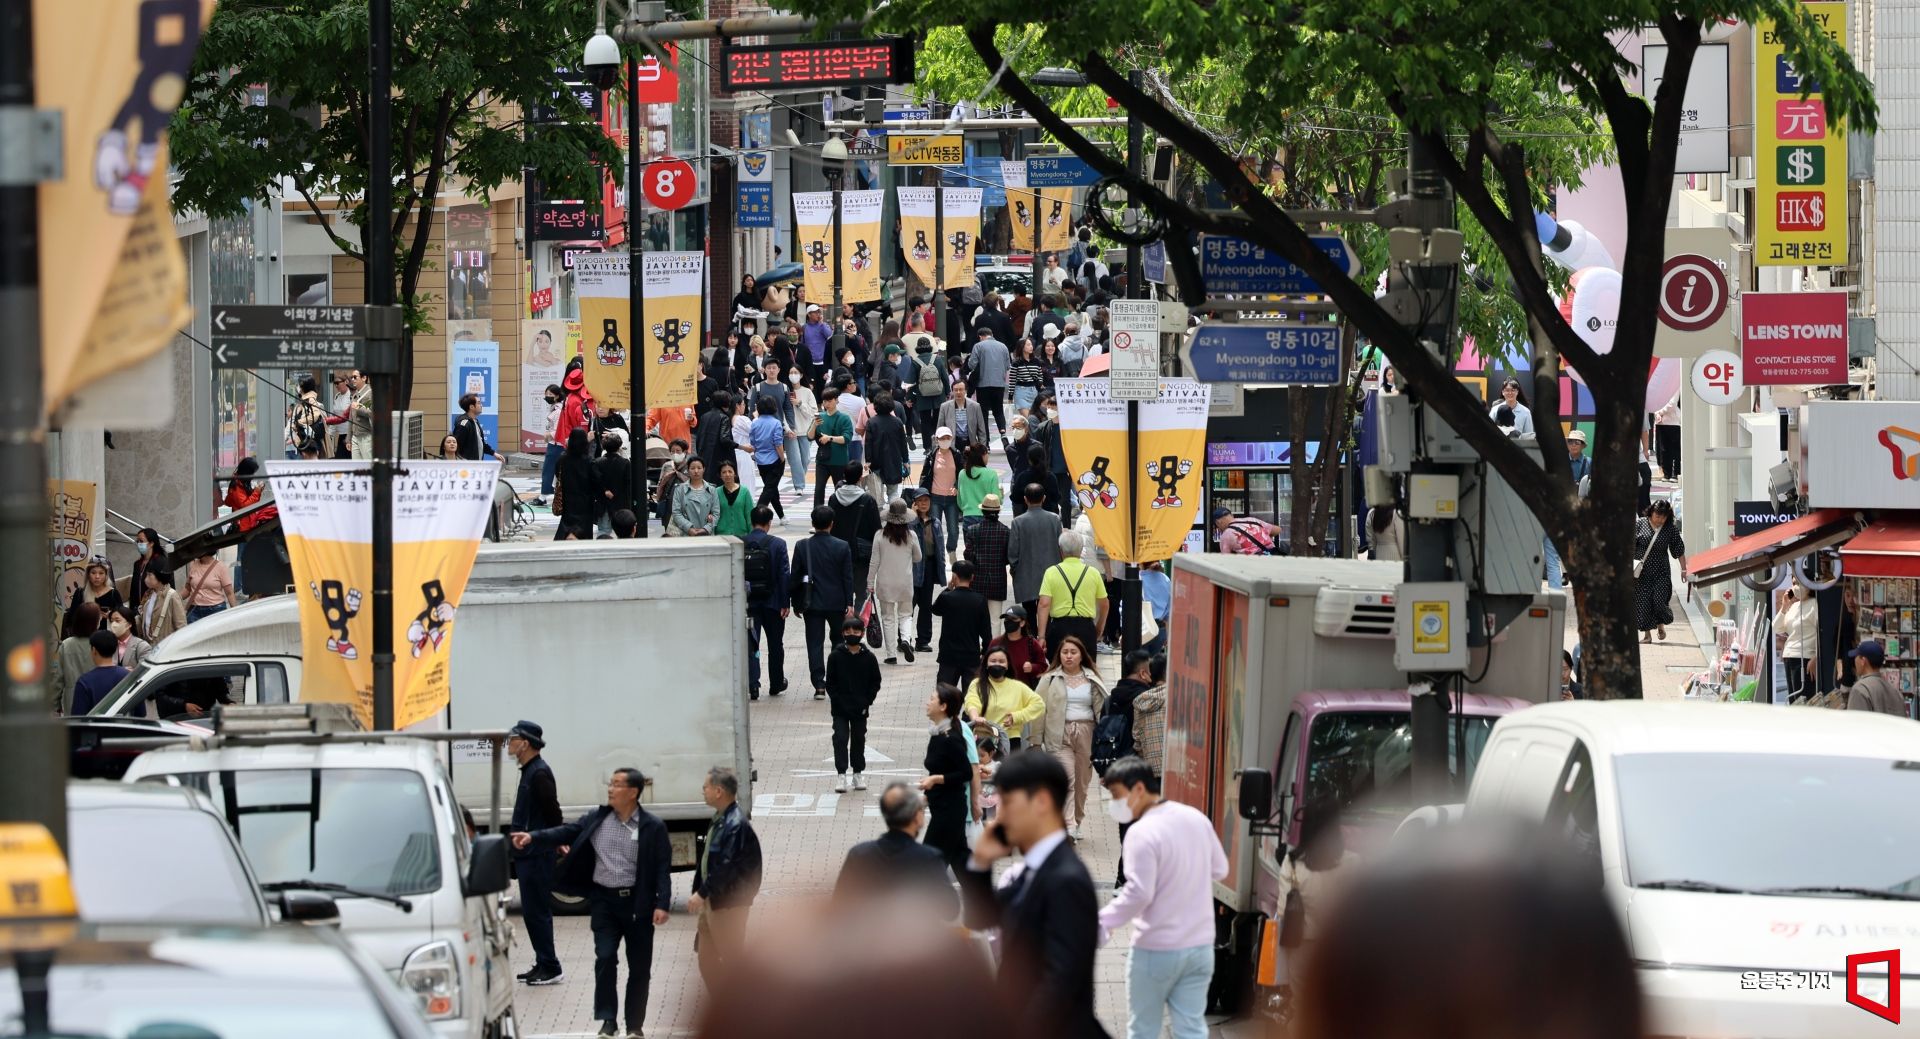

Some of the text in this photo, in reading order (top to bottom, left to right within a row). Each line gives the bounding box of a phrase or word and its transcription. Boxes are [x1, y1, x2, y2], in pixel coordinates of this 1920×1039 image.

[1782, 104, 1819, 135] 元
[904, 146, 961, 162] CCTV작동중
[1030, 159, 1058, 170] 명동7길
[1787, 148, 1814, 183] $
[1030, 170, 1082, 179] Myeongdong 7-gil
[1779, 195, 1824, 227] HK$
[1207, 239, 1341, 259] 명동9길 52
[1769, 242, 1832, 260] 고래환전
[1206, 263, 1286, 278] Myeongdong
[284, 308, 354, 322] 이회영 기념관
[1266, 330, 1336, 350] 명동10길
[1748, 324, 1843, 340] LENS TOWN
[278, 340, 355, 354] 솔라리아호텔
[1200, 337, 1211, 347] 62
[1216, 352, 1336, 368] Myeongdong 10-gil
[1754, 355, 1836, 365] CONTACT LENS STORE
[1703, 363, 1734, 395] 약
[1059, 390, 1107, 398] FESTIV
[1159, 390, 1206, 398] STIVAL
[1184, 614, 1199, 669] AIR
[1172, 671, 1206, 749] BAKED
